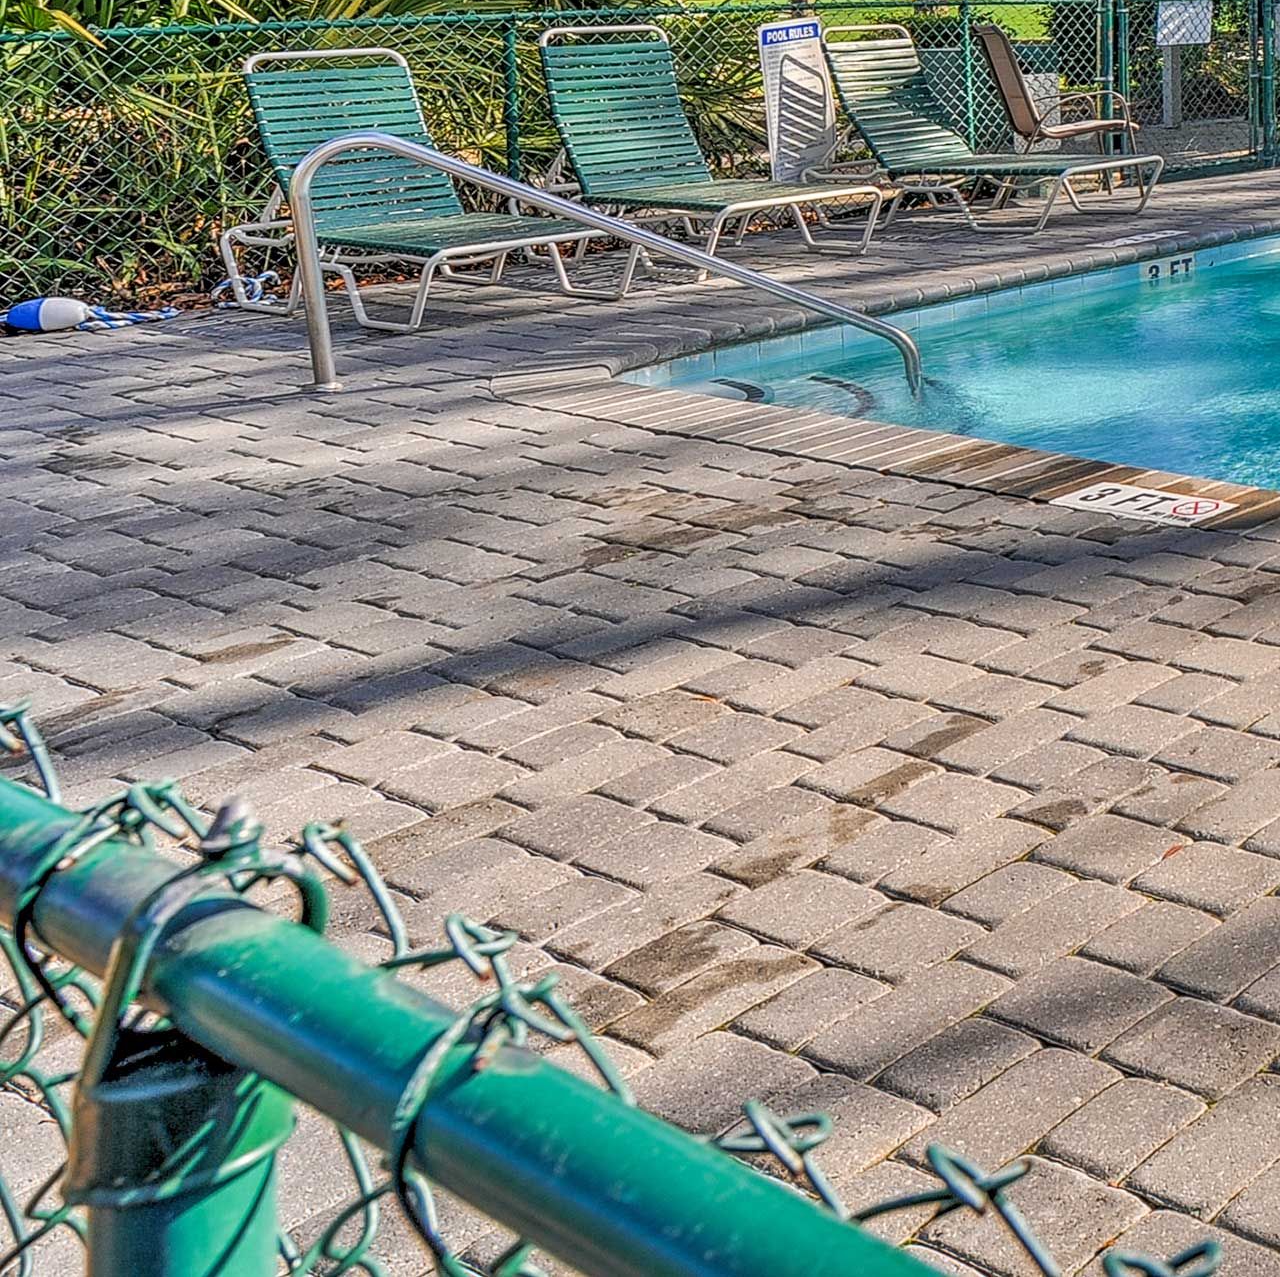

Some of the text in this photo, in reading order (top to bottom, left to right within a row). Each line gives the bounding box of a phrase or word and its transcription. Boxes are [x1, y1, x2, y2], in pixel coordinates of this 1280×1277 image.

[766, 26, 814, 43] POOL RULES
[1170, 257, 1193, 276] FT
[1078, 488, 1179, 512] 3 FT
